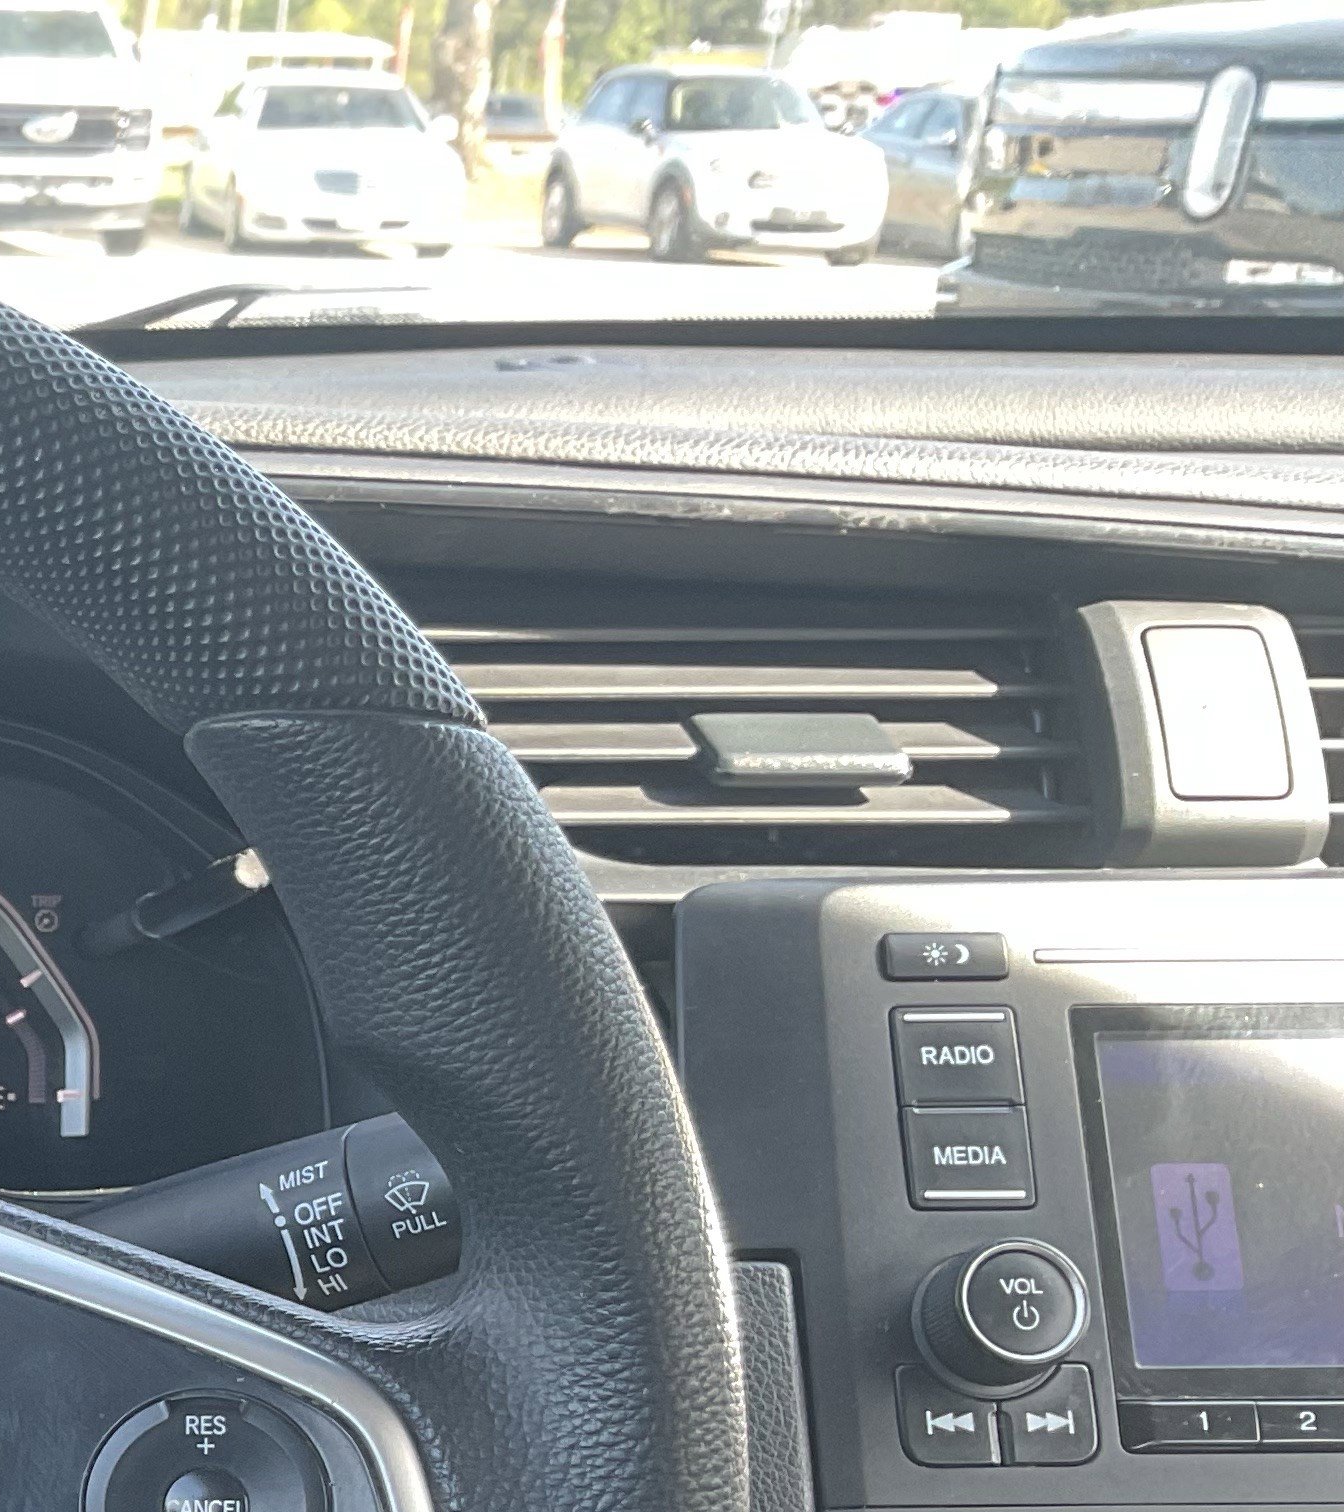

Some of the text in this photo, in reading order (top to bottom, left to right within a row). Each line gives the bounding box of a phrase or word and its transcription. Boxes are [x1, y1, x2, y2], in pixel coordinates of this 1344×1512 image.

[920, 1045, 995, 1067] RADIO
[933, 1145, 1007, 1167] MEDIA
[278, 1160, 329, 1191] MIST
[294, 1191, 343, 1226] OFF
[303, 1217, 345, 1250] INT
[391, 1211, 448, 1240] PULL
[310, 1246, 349, 1274] LO
[316, 1273, 349, 1297] HI
[999, 1277, 1044, 1297] VOL
[184, 1415, 228, 1436] RES
[1199, 1412, 1209, 1430] 1
[1299, 1411, 1318, 1431] 2
